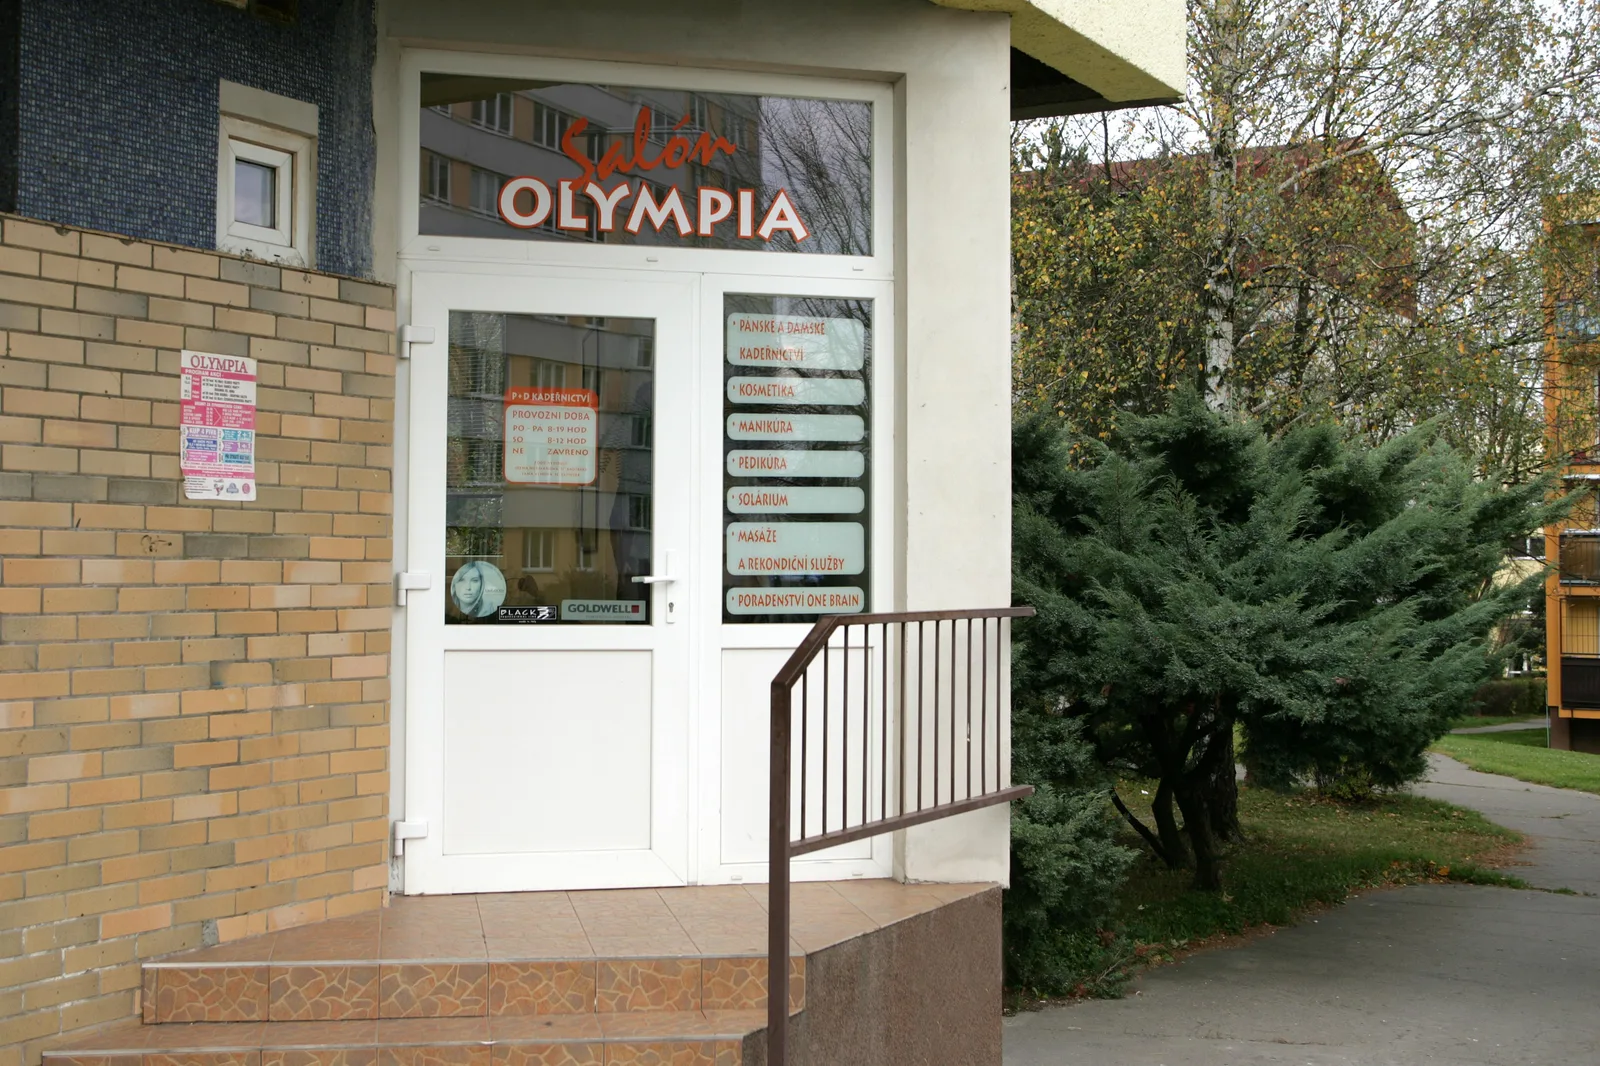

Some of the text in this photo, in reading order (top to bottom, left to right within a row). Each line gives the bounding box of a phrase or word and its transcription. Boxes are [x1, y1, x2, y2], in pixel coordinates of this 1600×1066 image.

[561, 105, 737, 191] Salón
[497, 175, 811, 243] OLYMPIA
[739, 315, 775, 333] PÁNSKÉ
[777, 321, 784, 333] A
[739, 345, 804, 361] KADEŘNICTVÍ
[190, 354, 248, 373] OLYMPIA
[185, 368, 209, 377] PROGRAM
[531, 391, 590, 403] KADEŘNICTVÍ
[739, 383, 794, 397] KOSMETIKA
[564, 411, 590, 421] DOBA
[512, 424, 525, 432] PO
[567, 426, 587, 434] HOD
[738, 417, 793, 433] MANIKÚRA
[567, 437, 587, 445] HOD
[738, 453, 787, 469] PEDIKÚRA
[738, 490, 789, 506] SOLÁRIUM
[738, 526, 777, 543] MASÁŽE
[738, 554, 845, 571] A REKONDIČNÍ SLUŽBY
[738, 591, 859, 607] PORADENSTVÍ ONE BRAIN
[568, 603, 632, 614] GOLDWELL
